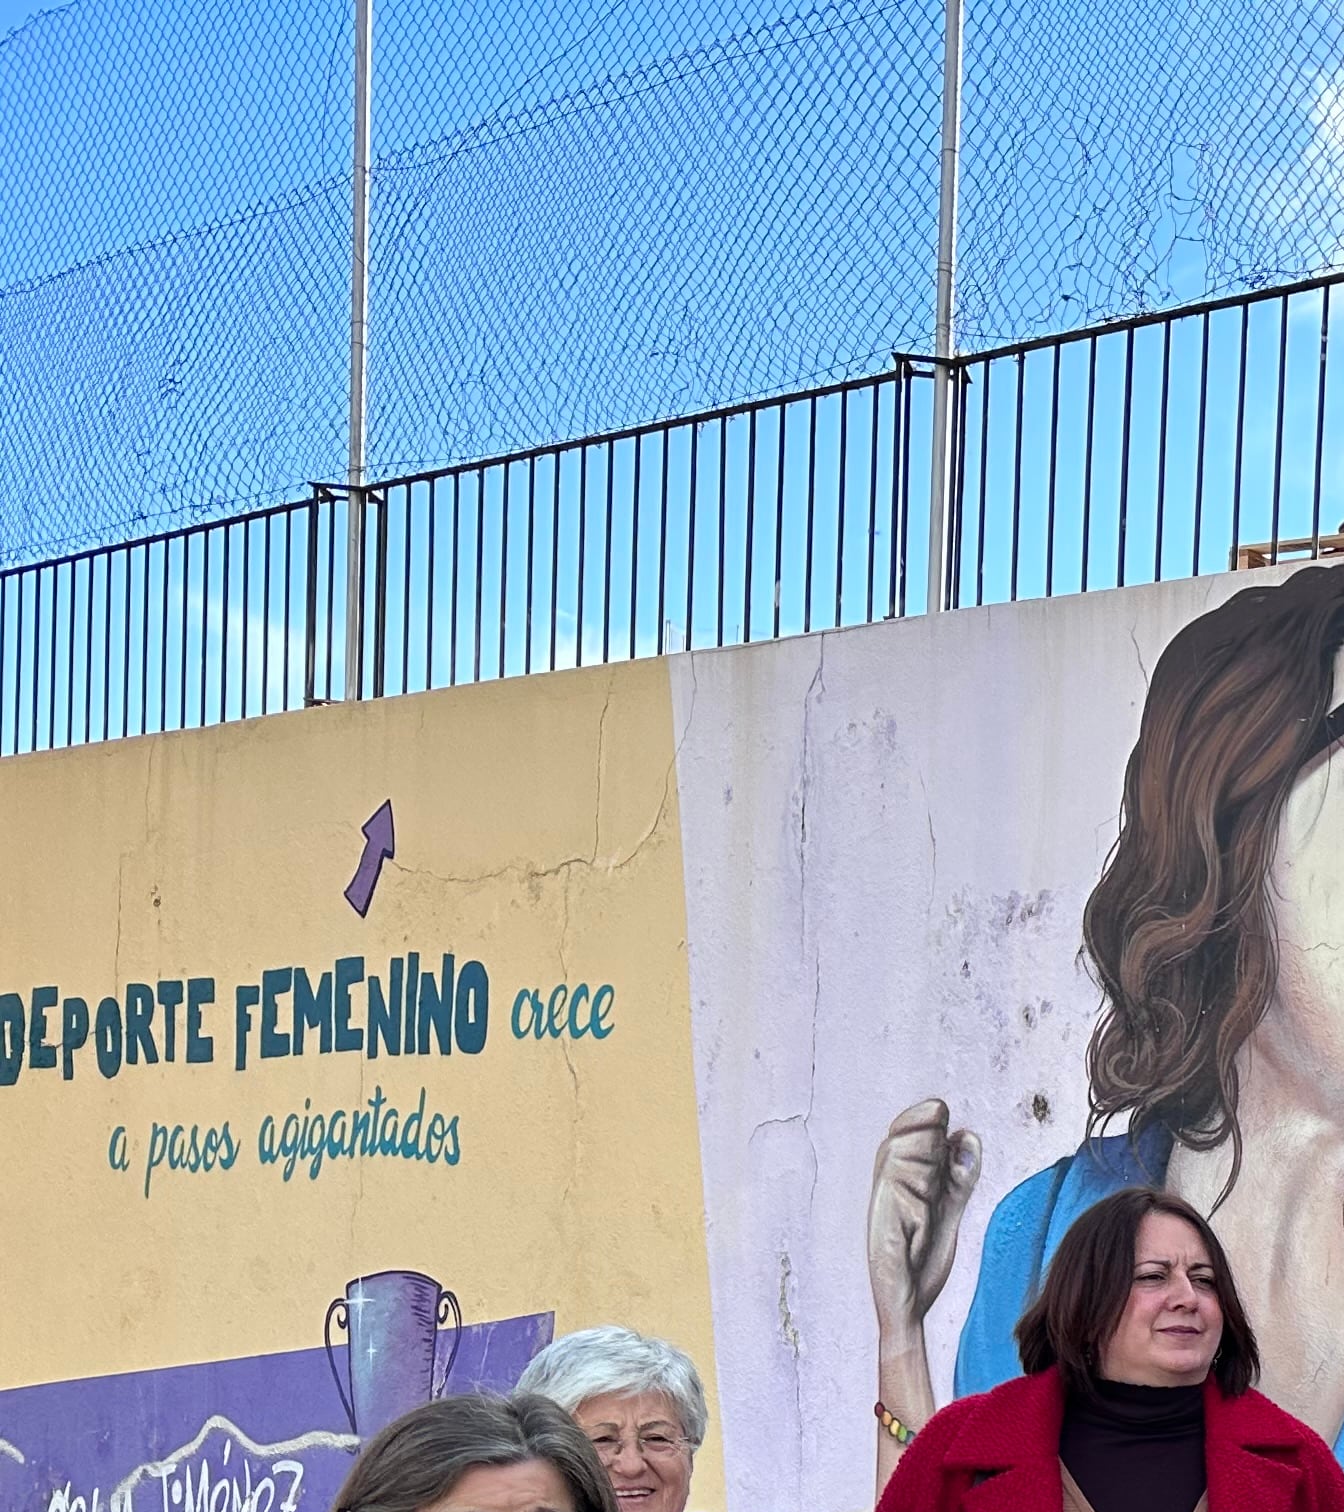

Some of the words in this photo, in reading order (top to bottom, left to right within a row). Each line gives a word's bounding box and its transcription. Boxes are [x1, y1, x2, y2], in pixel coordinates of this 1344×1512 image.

[0, 977, 215, 1087] DEPORTE
[235, 950, 490, 1071] FEMENINO
[510, 980, 617, 1040] crece
[107, 1125, 130, 1172] a
[144, 1119, 242, 1201] pasos
[258, 1084, 461, 1182] agigantados
